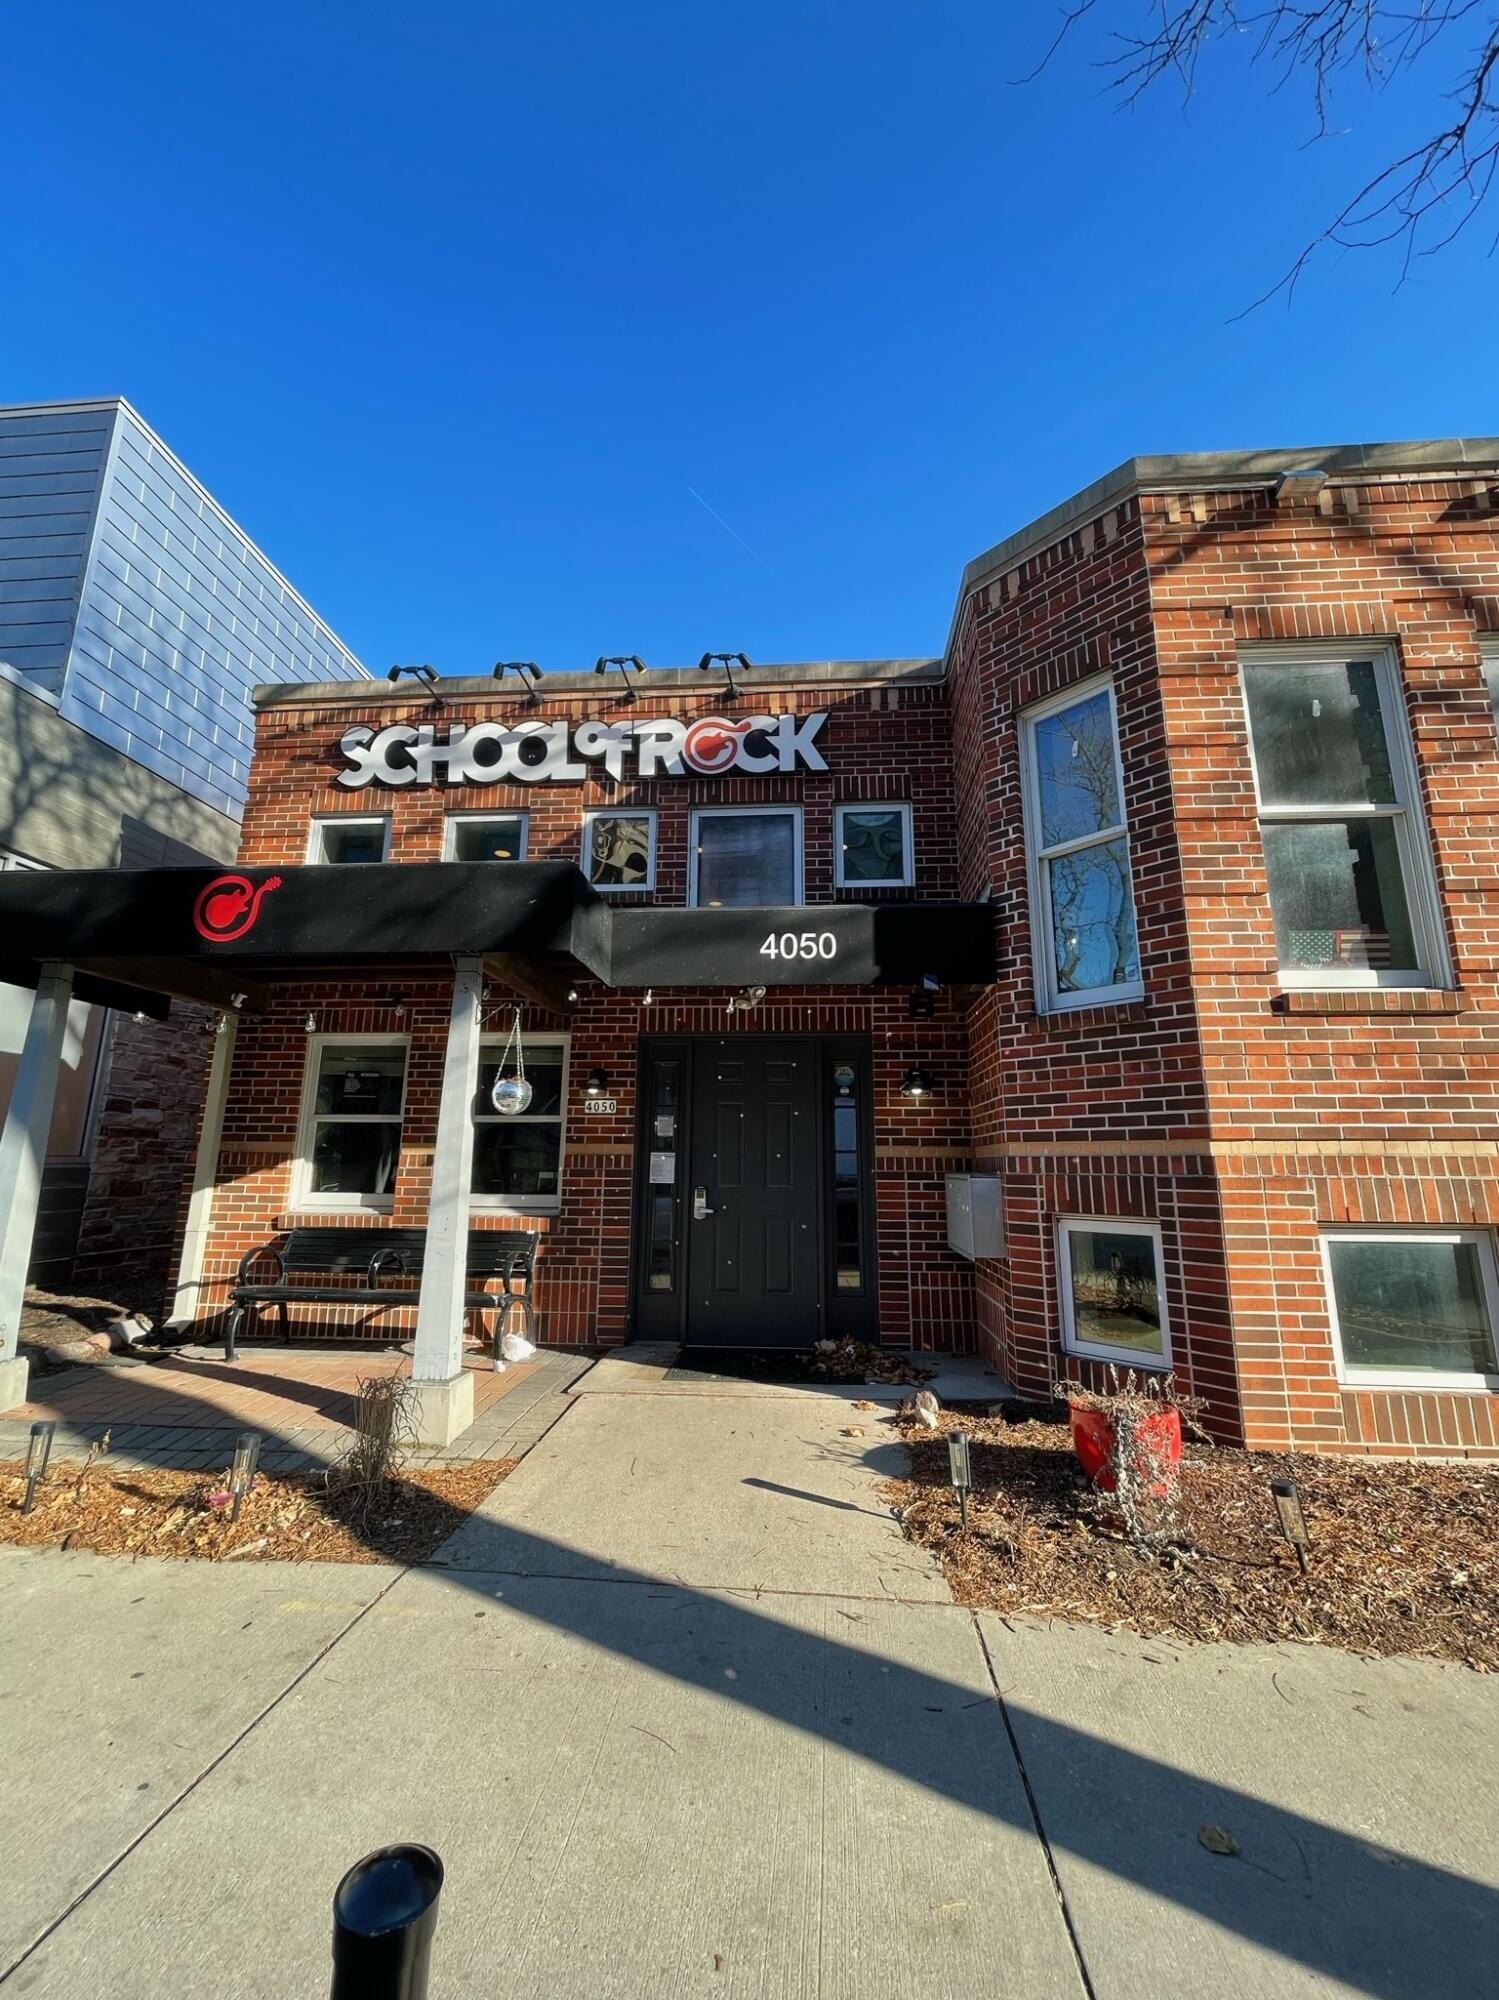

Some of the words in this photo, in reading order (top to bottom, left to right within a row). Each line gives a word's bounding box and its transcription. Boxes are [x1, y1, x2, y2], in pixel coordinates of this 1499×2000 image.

[336, 720, 587, 787] SCHOOL
[633, 712, 830, 776] ROCK
[759, 932, 837, 960] 4050
[586, 1101, 616, 1113] 4050
